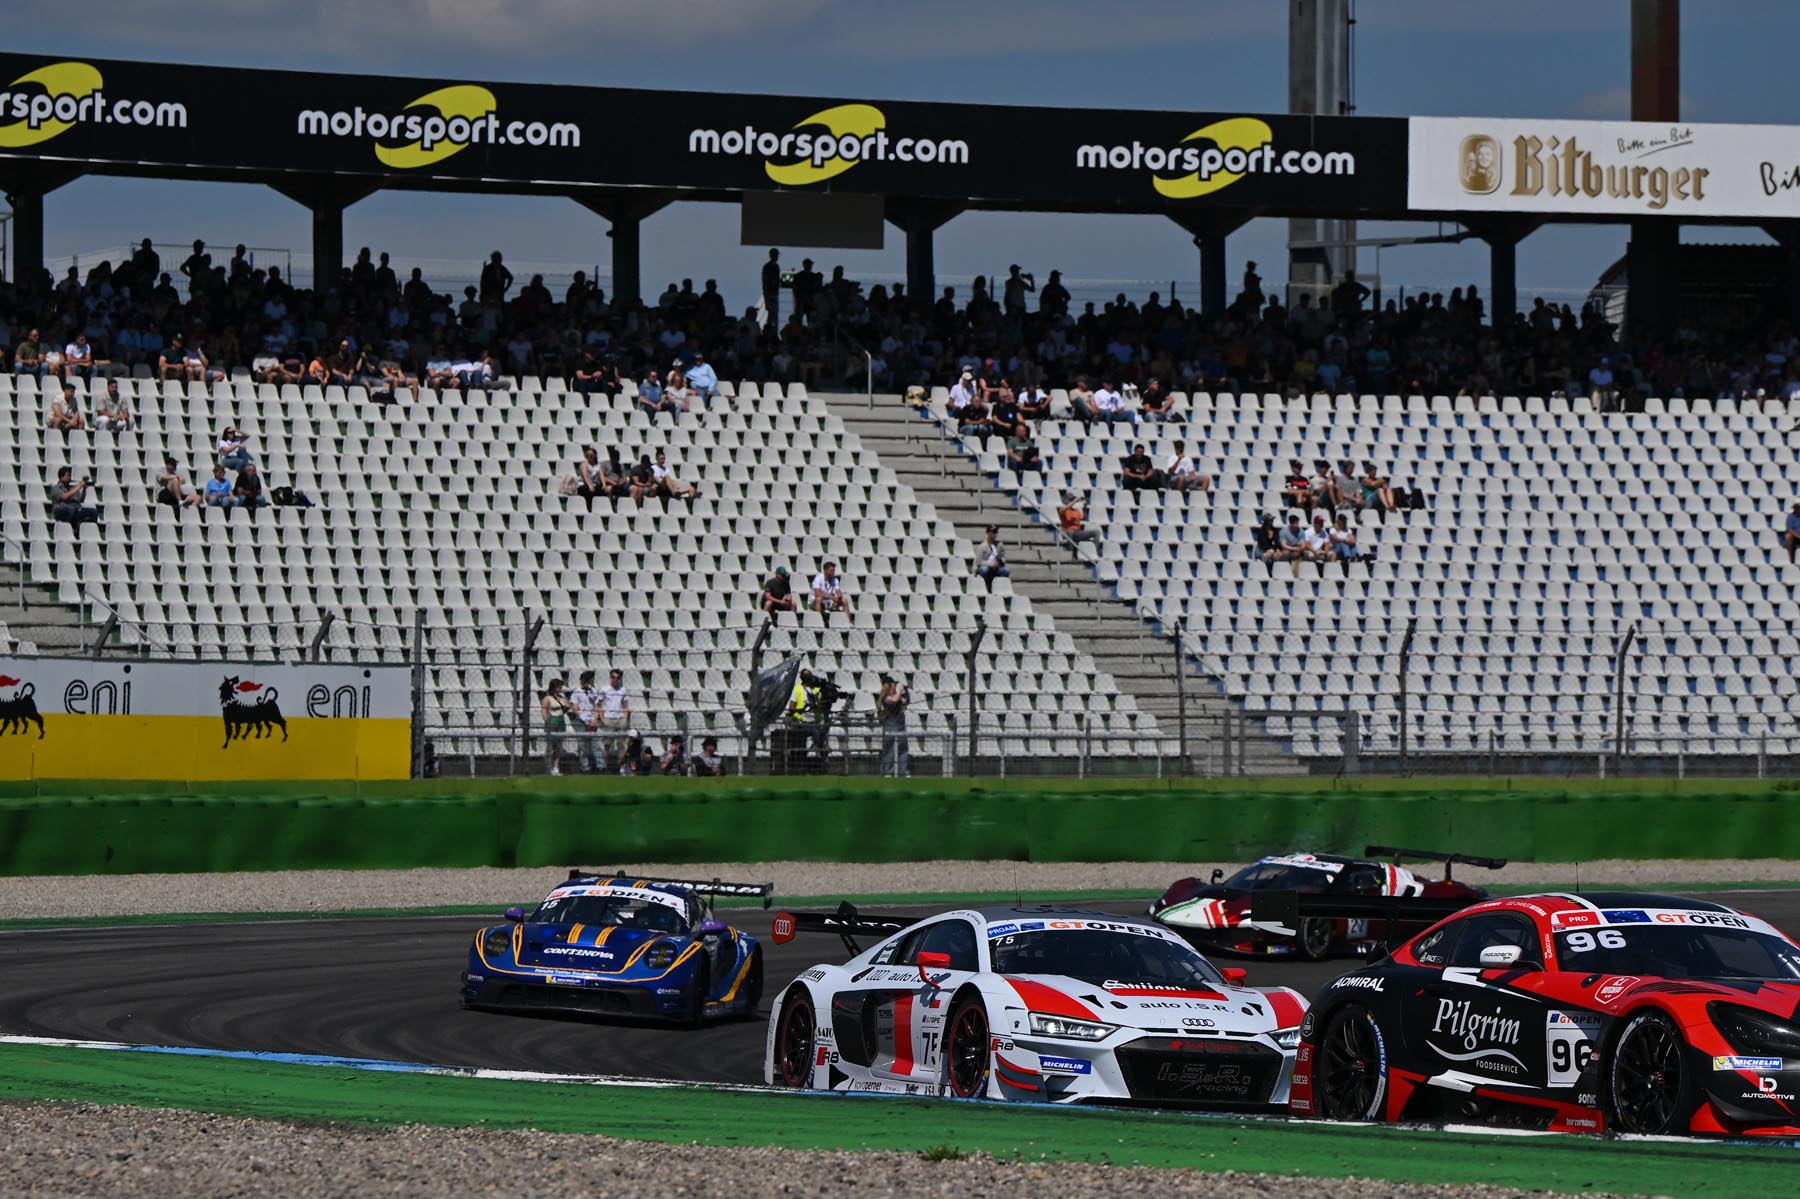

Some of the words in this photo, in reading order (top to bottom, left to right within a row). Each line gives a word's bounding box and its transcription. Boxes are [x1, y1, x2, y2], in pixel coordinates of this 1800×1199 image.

[298, 107, 581, 151] motorsport.com
[688, 124, 969, 168] motorsport.com
[1076, 140, 1355, 181] motorsport.com
[1510, 134, 1710, 210] Bitburger
[64, 664, 131, 716] eni
[306, 669, 371, 719] eni
[1568, 915, 1589, 923] PRO
[988, 924, 1018, 936] PROAM
[994, 935, 1015, 946] 75
[1566, 929, 1627, 953] 96
[543, 946, 615, 961] CONTINOVA
[888, 973, 912, 982] auto
[1331, 977, 1385, 992] ADMIRAL
[1140, 1000, 1181, 1009] auto
[1186, 1002, 1235, 1013] I.S.R.
[1431, 998, 1521, 1050] Pilgrim
[996, 1041, 1014, 1051] R8
[823, 1051, 839, 1064] R8
[1552, 1038, 1593, 1073] 96
[1042, 1061, 1084, 1070] MICHELIN
[1475, 1059, 1519, 1074] FOODSERVICE
[1741, 1092, 1796, 1101] AUTOMOTIVE
